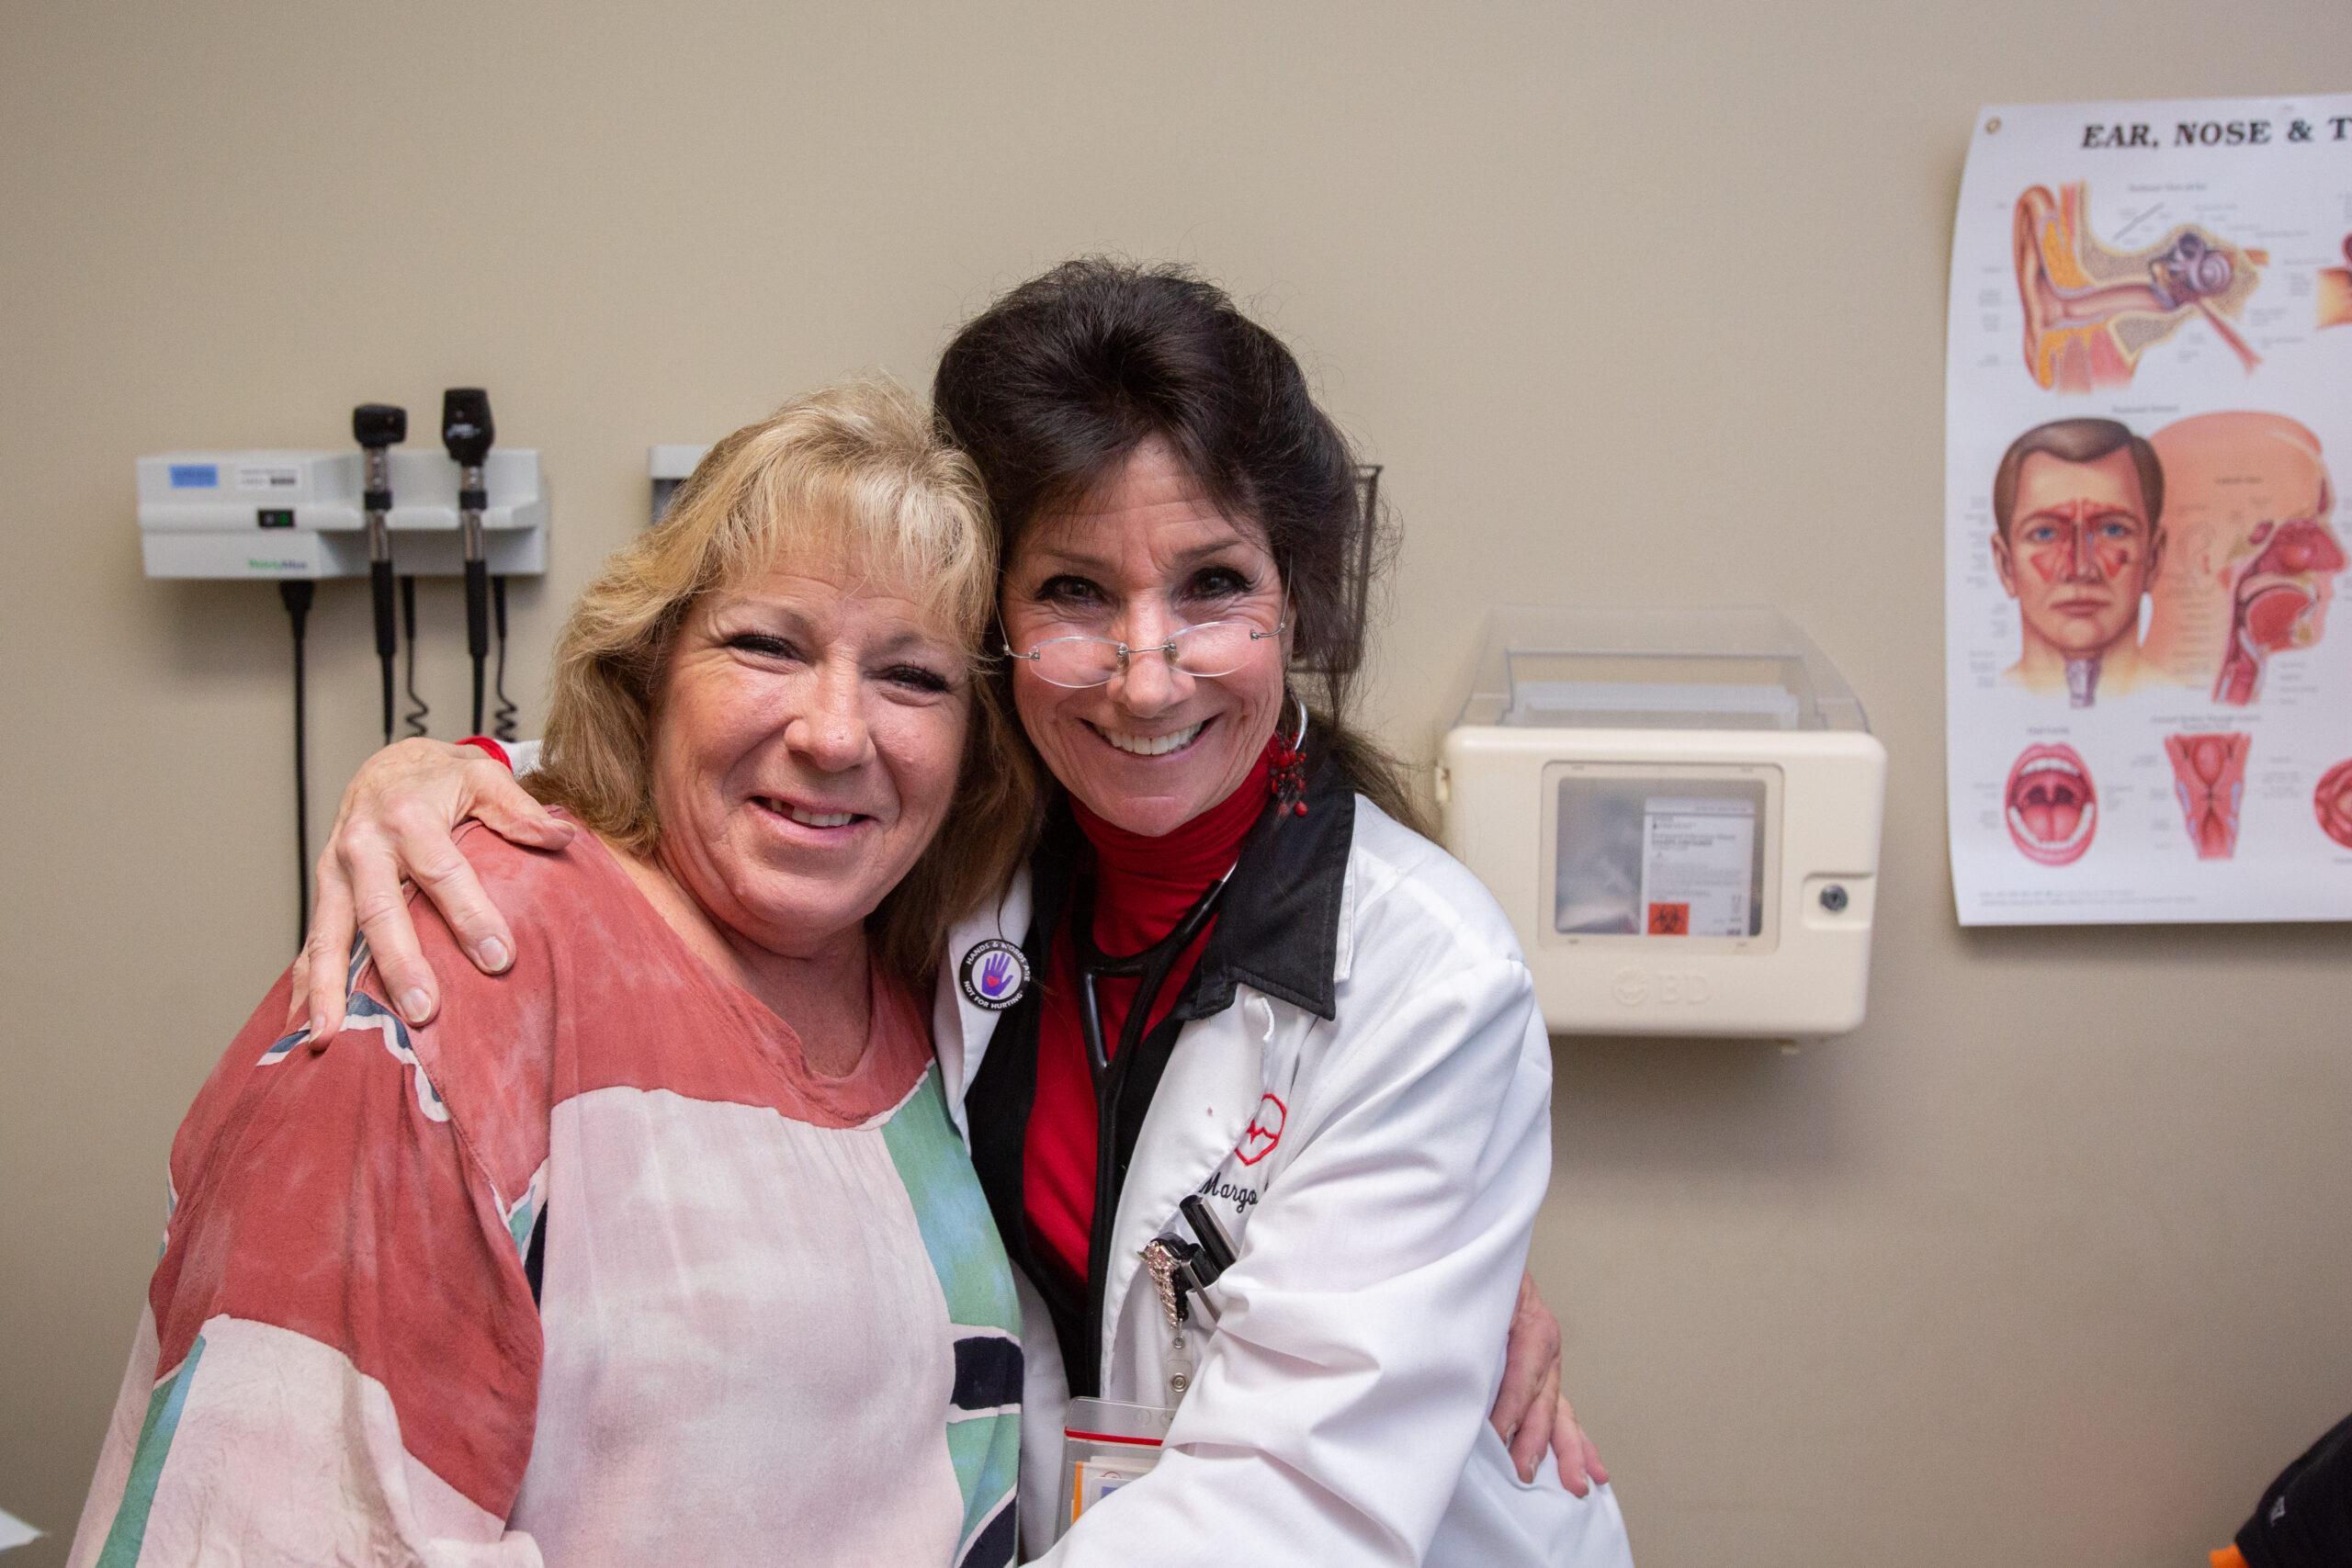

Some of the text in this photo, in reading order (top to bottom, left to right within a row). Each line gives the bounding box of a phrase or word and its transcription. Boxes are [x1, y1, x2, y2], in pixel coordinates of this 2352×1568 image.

[2082, 123, 2158, 149] EAR,
[2175, 119, 2271, 146] NOSE
[2287, 118, 2312, 141] &
[966, 942, 989, 964] HANDS
[1001, 942, 1027, 963] WORDS
[1023, 965, 1031, 981] ARE
[964, 980, 1023, 1010] NOT FOR HURTING
[1198, 1171, 1259, 1213] Margo
